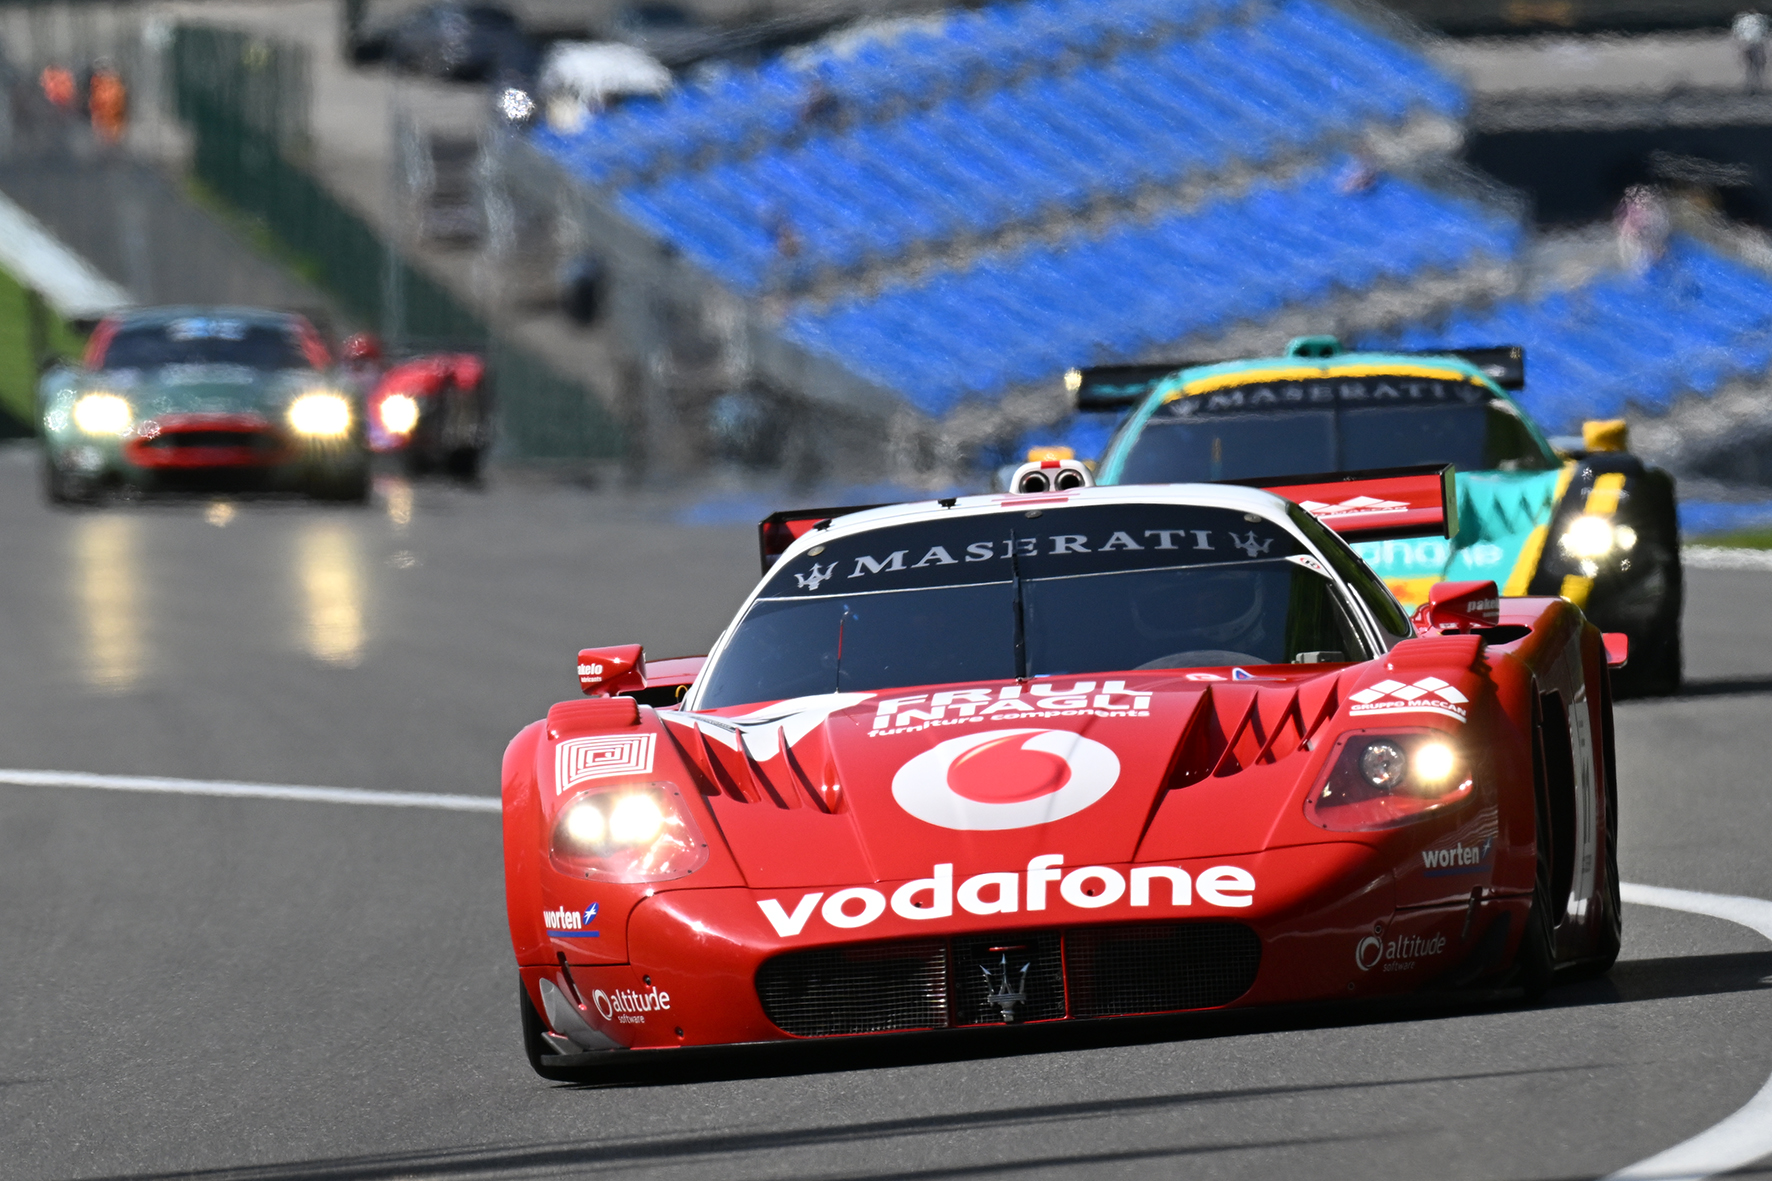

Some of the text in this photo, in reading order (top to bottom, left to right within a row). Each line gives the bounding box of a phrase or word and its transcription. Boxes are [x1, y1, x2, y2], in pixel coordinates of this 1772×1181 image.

[1208, 381, 1445, 411] MASERATI
[846, 528, 1217, 578] MASERATI
[872, 694, 1151, 729] INTAGLI
[876, 680, 1153, 716] FRIUL
[1350, 699, 1467, 716] GRUPPO MACCAN
[867, 708, 1151, 737] furniture components
[1422, 842, 1479, 868] worten
[756, 853, 1257, 938] vodafone
[543, 904, 583, 930] worten
[1385, 932, 1446, 960] altitude
[1383, 960, 1416, 972] software
[611, 986, 671, 1014] altitude
[617, 1012, 645, 1024] software
